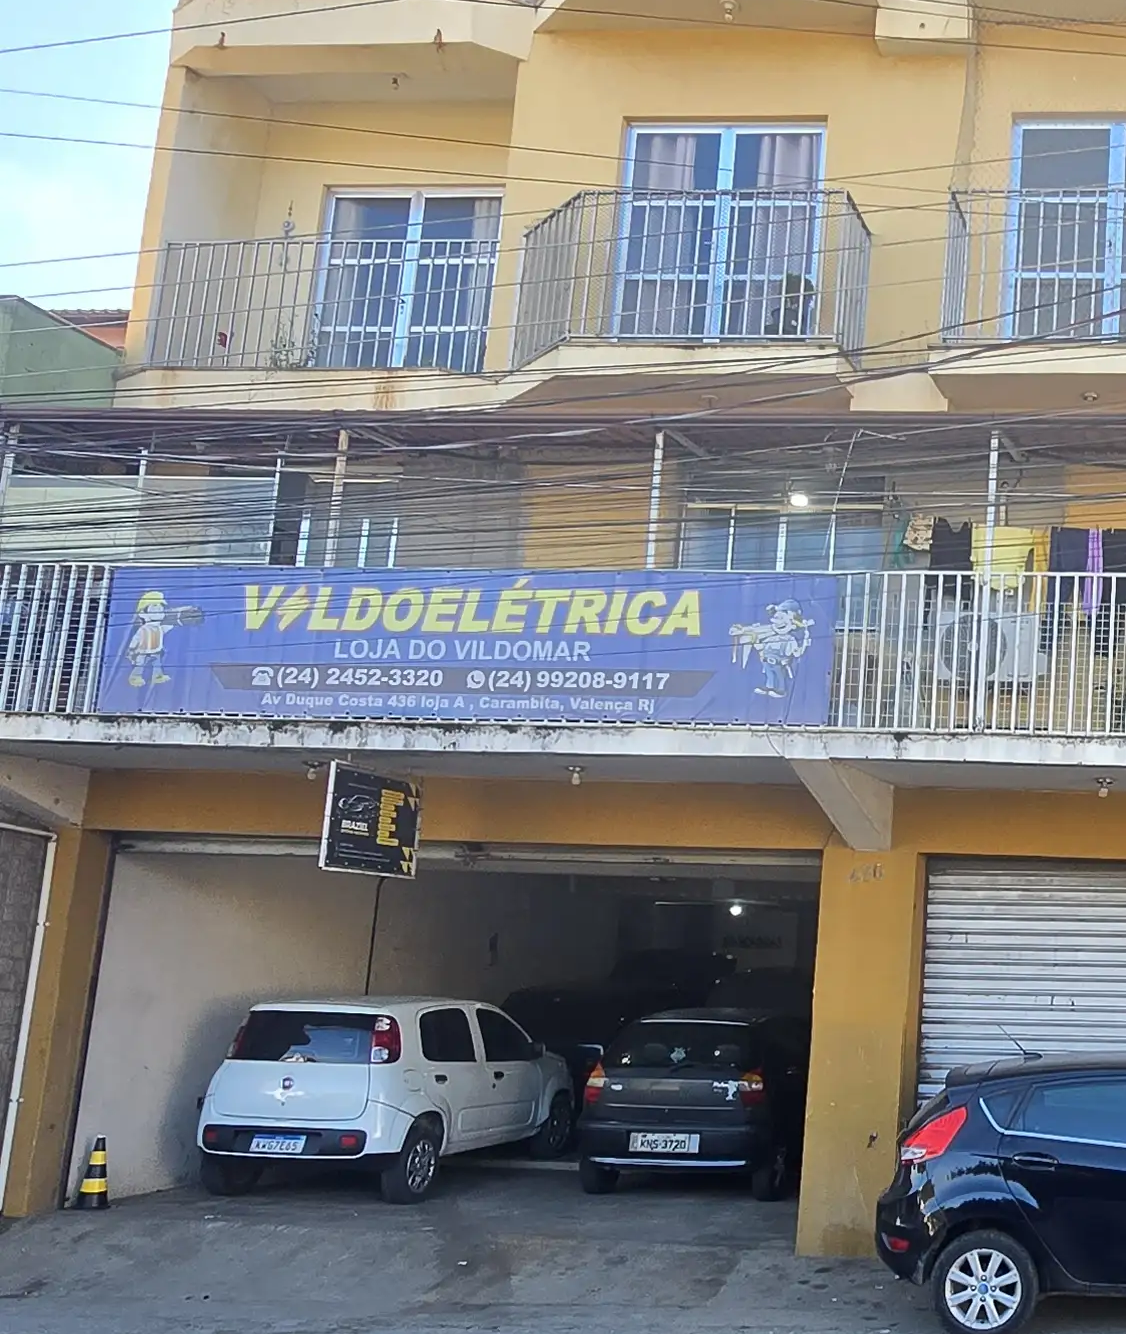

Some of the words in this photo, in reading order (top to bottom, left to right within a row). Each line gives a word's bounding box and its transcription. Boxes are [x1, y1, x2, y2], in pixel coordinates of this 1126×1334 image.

[333, 638, 400, 660] LOJA
[408, 639, 447, 660] DO
[454, 640, 591, 662] VILDOMAR
[276, 666, 320, 688] (24)
[326, 668, 443, 687] 2452-3320
[488, 670, 531, 692] (24)
[536, 671, 670, 690] 99208-9117
[261, 693, 281, 705] Av
[285, 693, 333, 708] Duque
[339, 694, 383, 707] Costa
[388, 695, 416, 708] 436
[421, 695, 449, 710] loja
[453, 696, 465, 708] A
[570, 697, 633, 713] Valença
